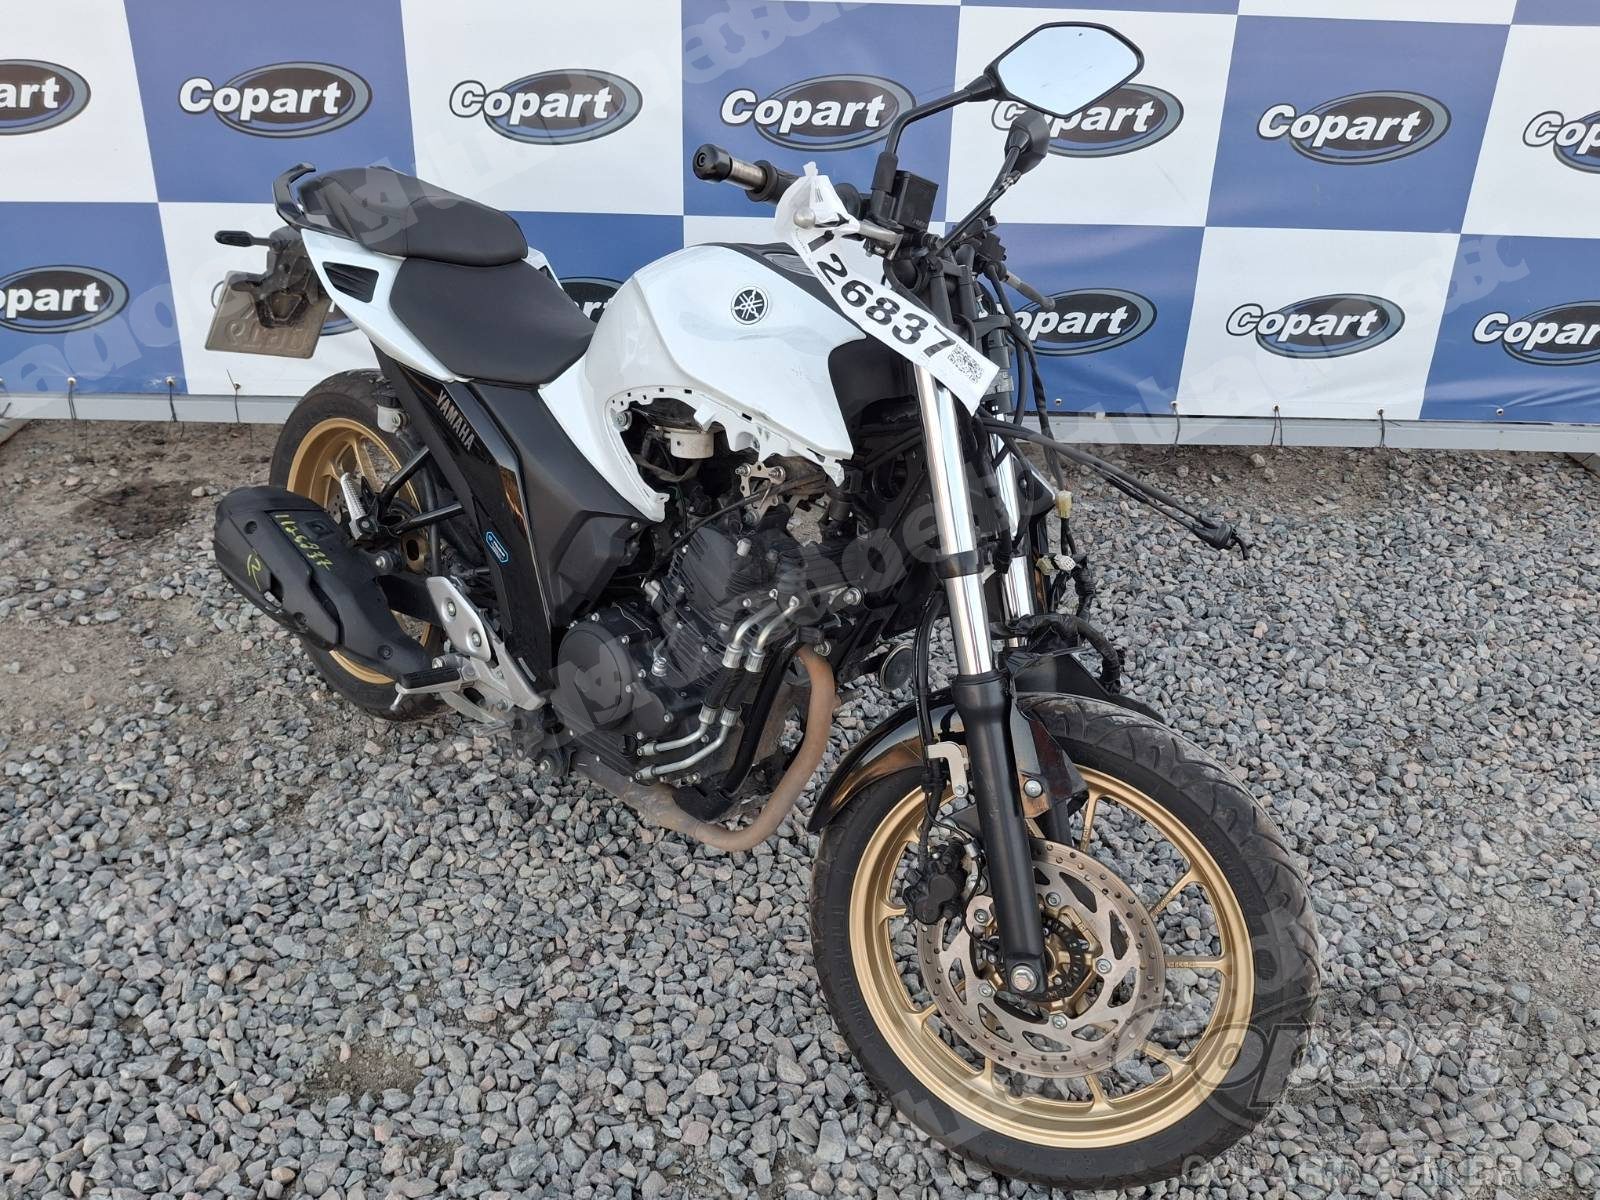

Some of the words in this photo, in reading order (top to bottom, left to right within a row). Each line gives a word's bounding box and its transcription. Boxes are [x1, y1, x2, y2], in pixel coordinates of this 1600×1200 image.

[0, 77, 60, 109] art
[179, 77, 342, 122] Copart
[449, 80, 613, 125] Copart
[720, 88, 886, 135] Copart
[992, 101, 1155, 138] Cpart
[1257, 103, 1422, 148] Copart
[0, 282, 100, 319] part
[985, 304, 1128, 341] opart
[1226, 303, 1378, 343] Copart
[436, 389, 475, 451] YAMAHA
